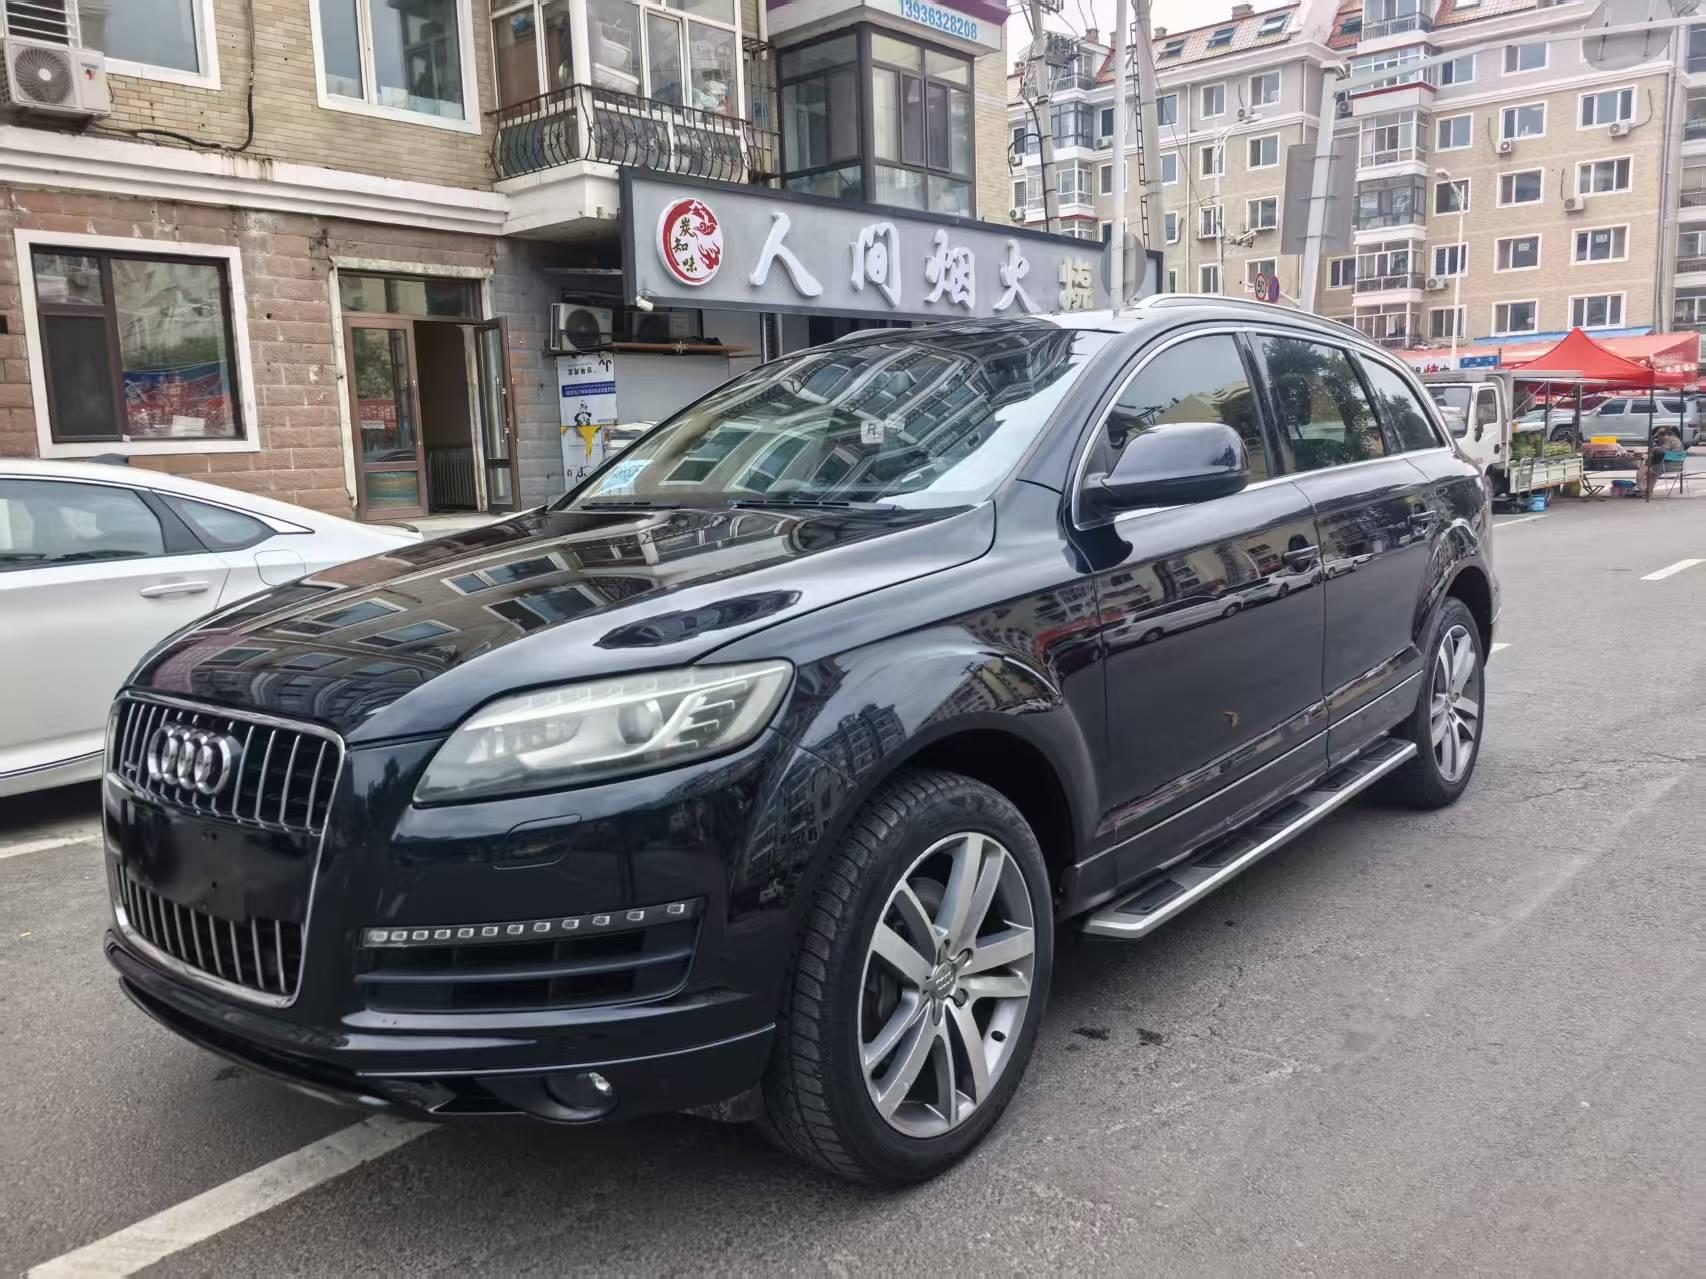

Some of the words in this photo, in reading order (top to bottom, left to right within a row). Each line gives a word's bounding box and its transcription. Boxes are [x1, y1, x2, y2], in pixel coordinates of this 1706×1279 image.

[899, 0, 977, 40] 13936328208
[672, 217, 698, 273] 炭知味
[748, 211, 1042, 313] 人间烟火
